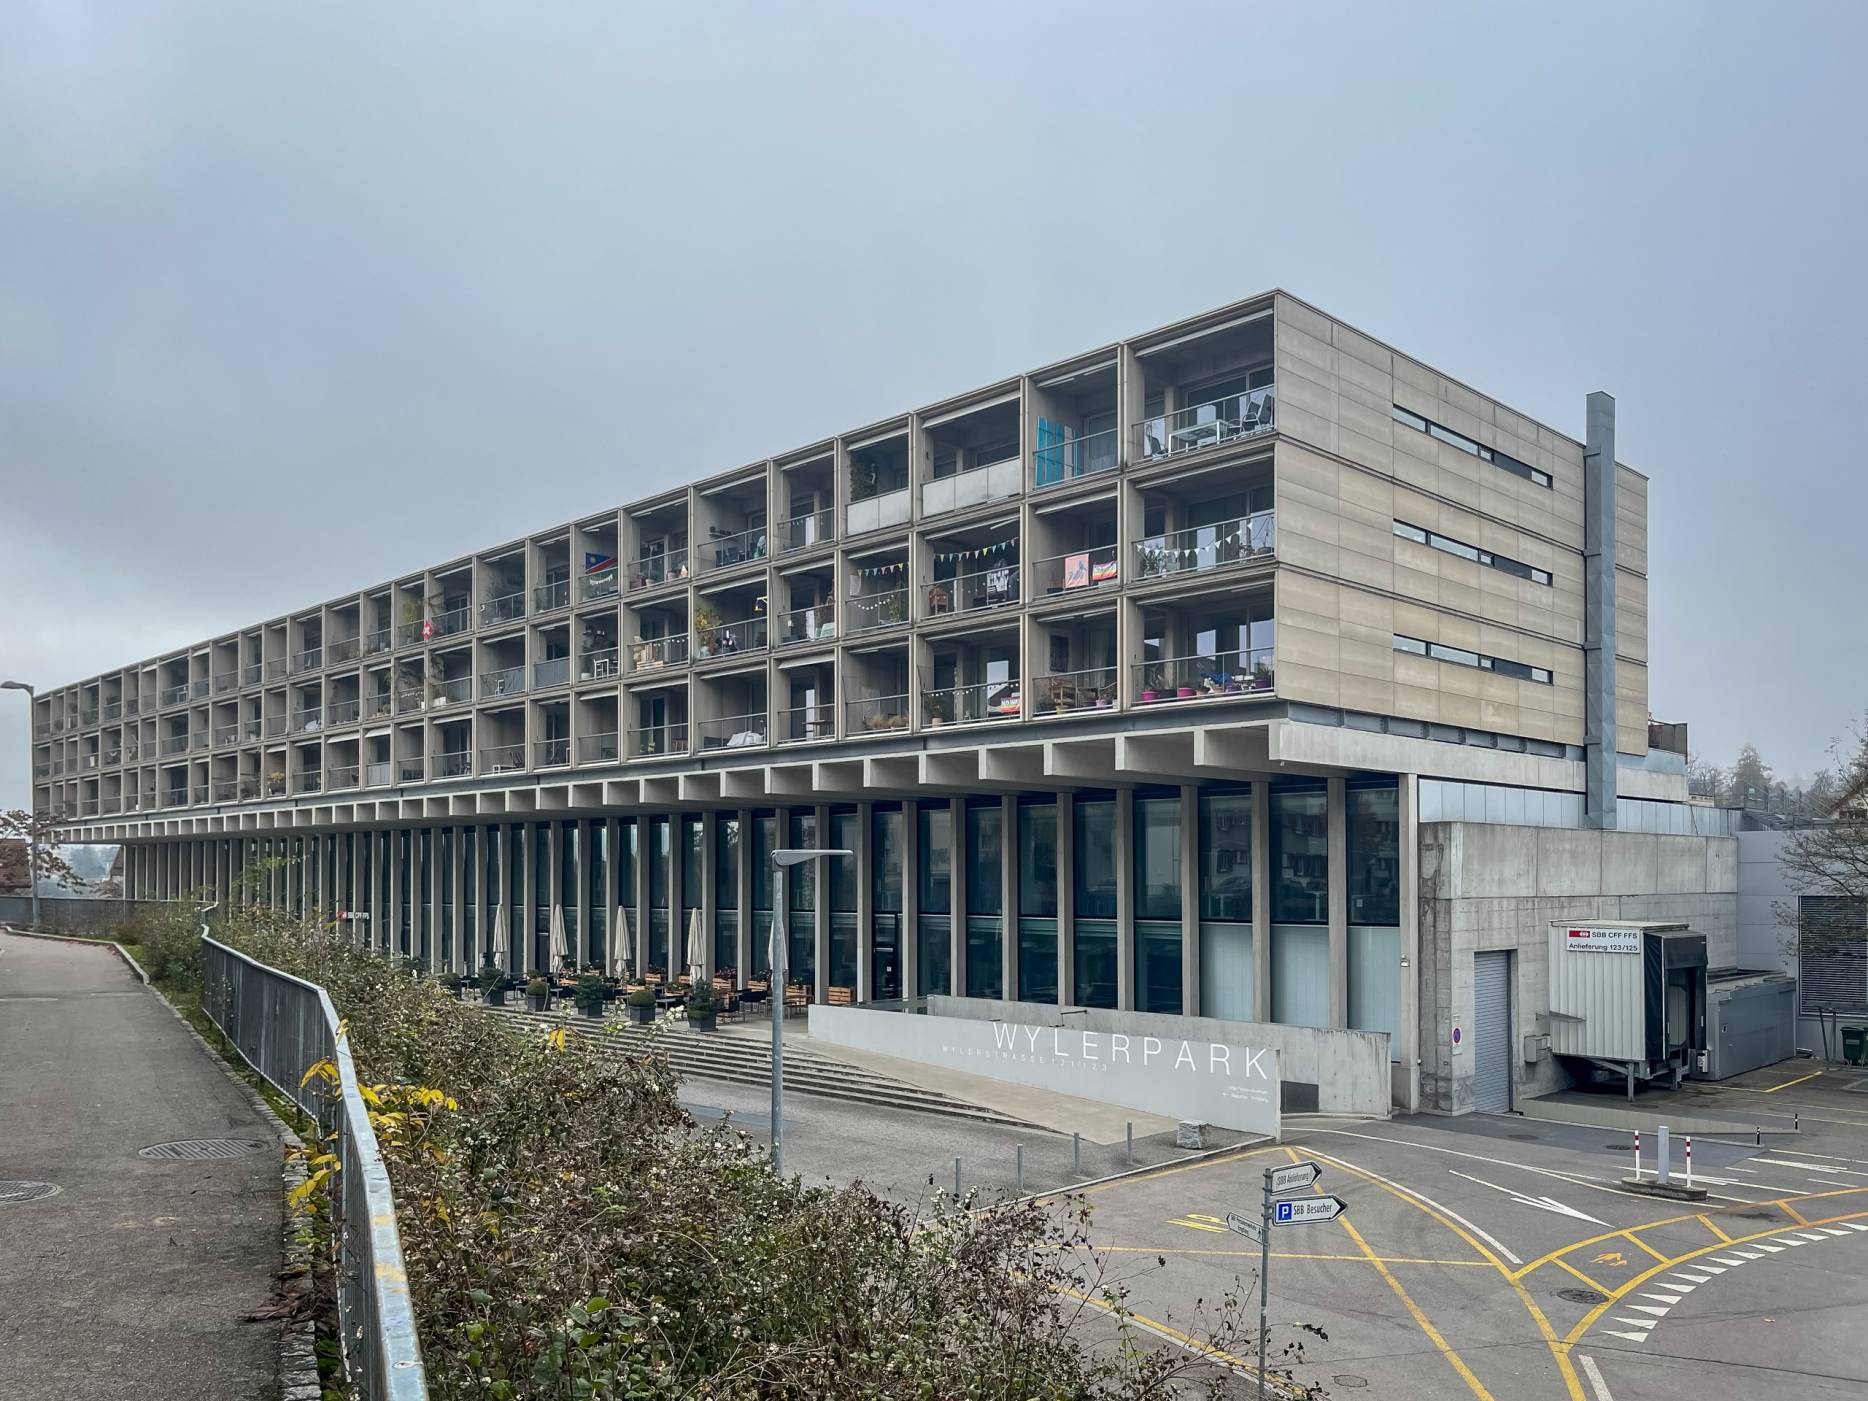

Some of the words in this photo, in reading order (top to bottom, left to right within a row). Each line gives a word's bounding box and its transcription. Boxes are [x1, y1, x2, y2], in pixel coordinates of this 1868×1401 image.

[1569, 943, 1608, 951] Anlieferung
[992, 1021, 1268, 1080] WYLERPARK
[1281, 1205, 1290, 1219] P
[1293, 1204, 1305, 1216] SBB
[1306, 1202, 1333, 1215] Besucher
